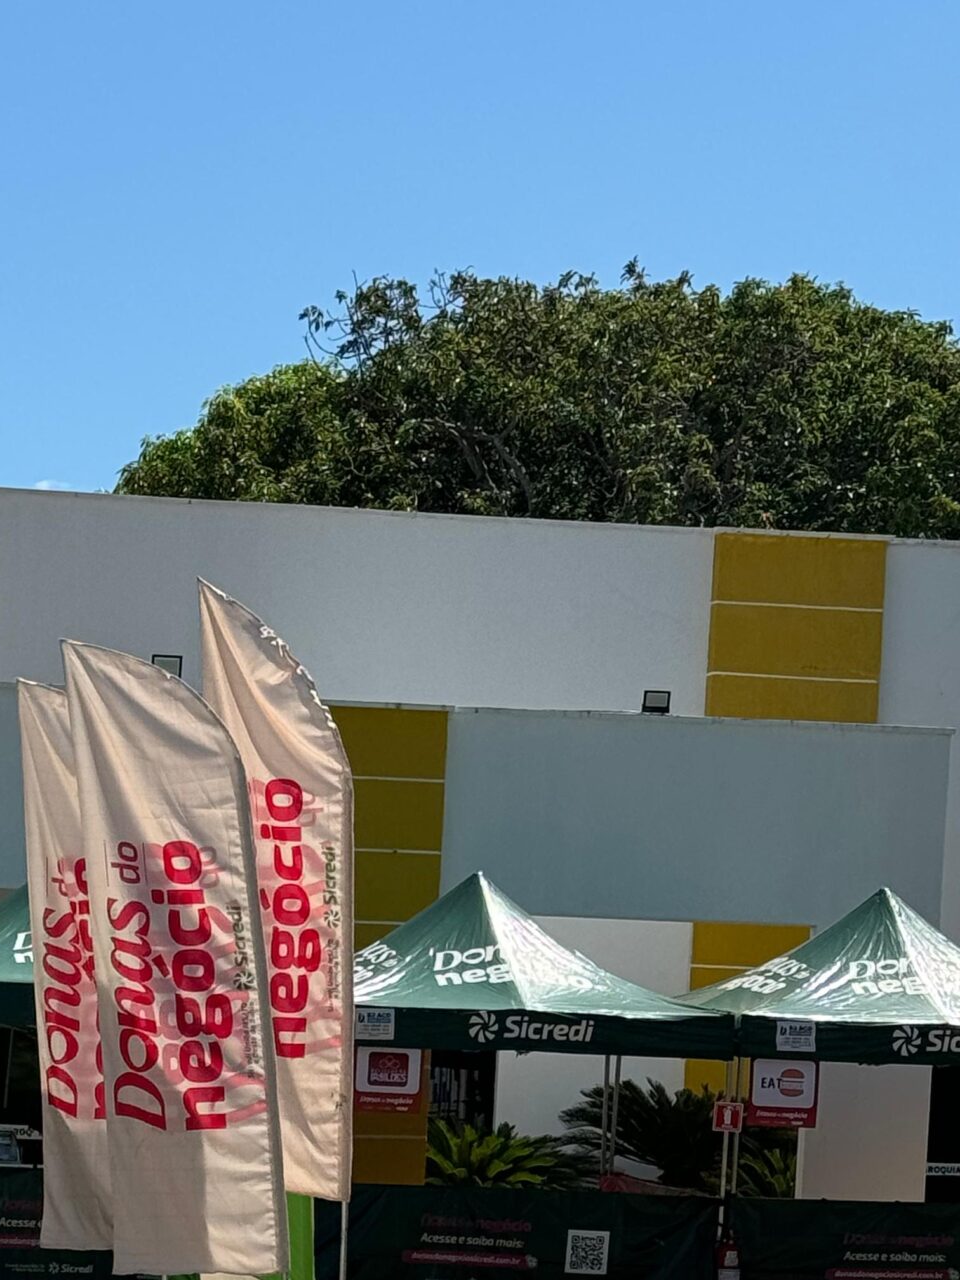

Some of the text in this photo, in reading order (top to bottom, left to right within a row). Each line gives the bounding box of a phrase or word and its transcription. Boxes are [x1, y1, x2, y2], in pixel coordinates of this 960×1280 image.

[321, 843, 338, 906] Sicredi
[225, 899, 249, 968] Sicredi
[260, 778, 323, 1060] negócio
[43, 908, 81, 1119] Donas
[107, 841, 167, 1131] Donas do
[151, 840, 233, 1131] negócio
[503, 1013, 595, 1043] Sicredi
[761, 1077, 783, 1089] EAT
[61, 1262, 94, 1274] Sicredi
[420, 1232, 457, 1244] Acesse
[465, 1235, 495, 1247] saiba
[842, 1251, 880, 1262] Acesse
[889, 1251, 918, 1263] saiba
